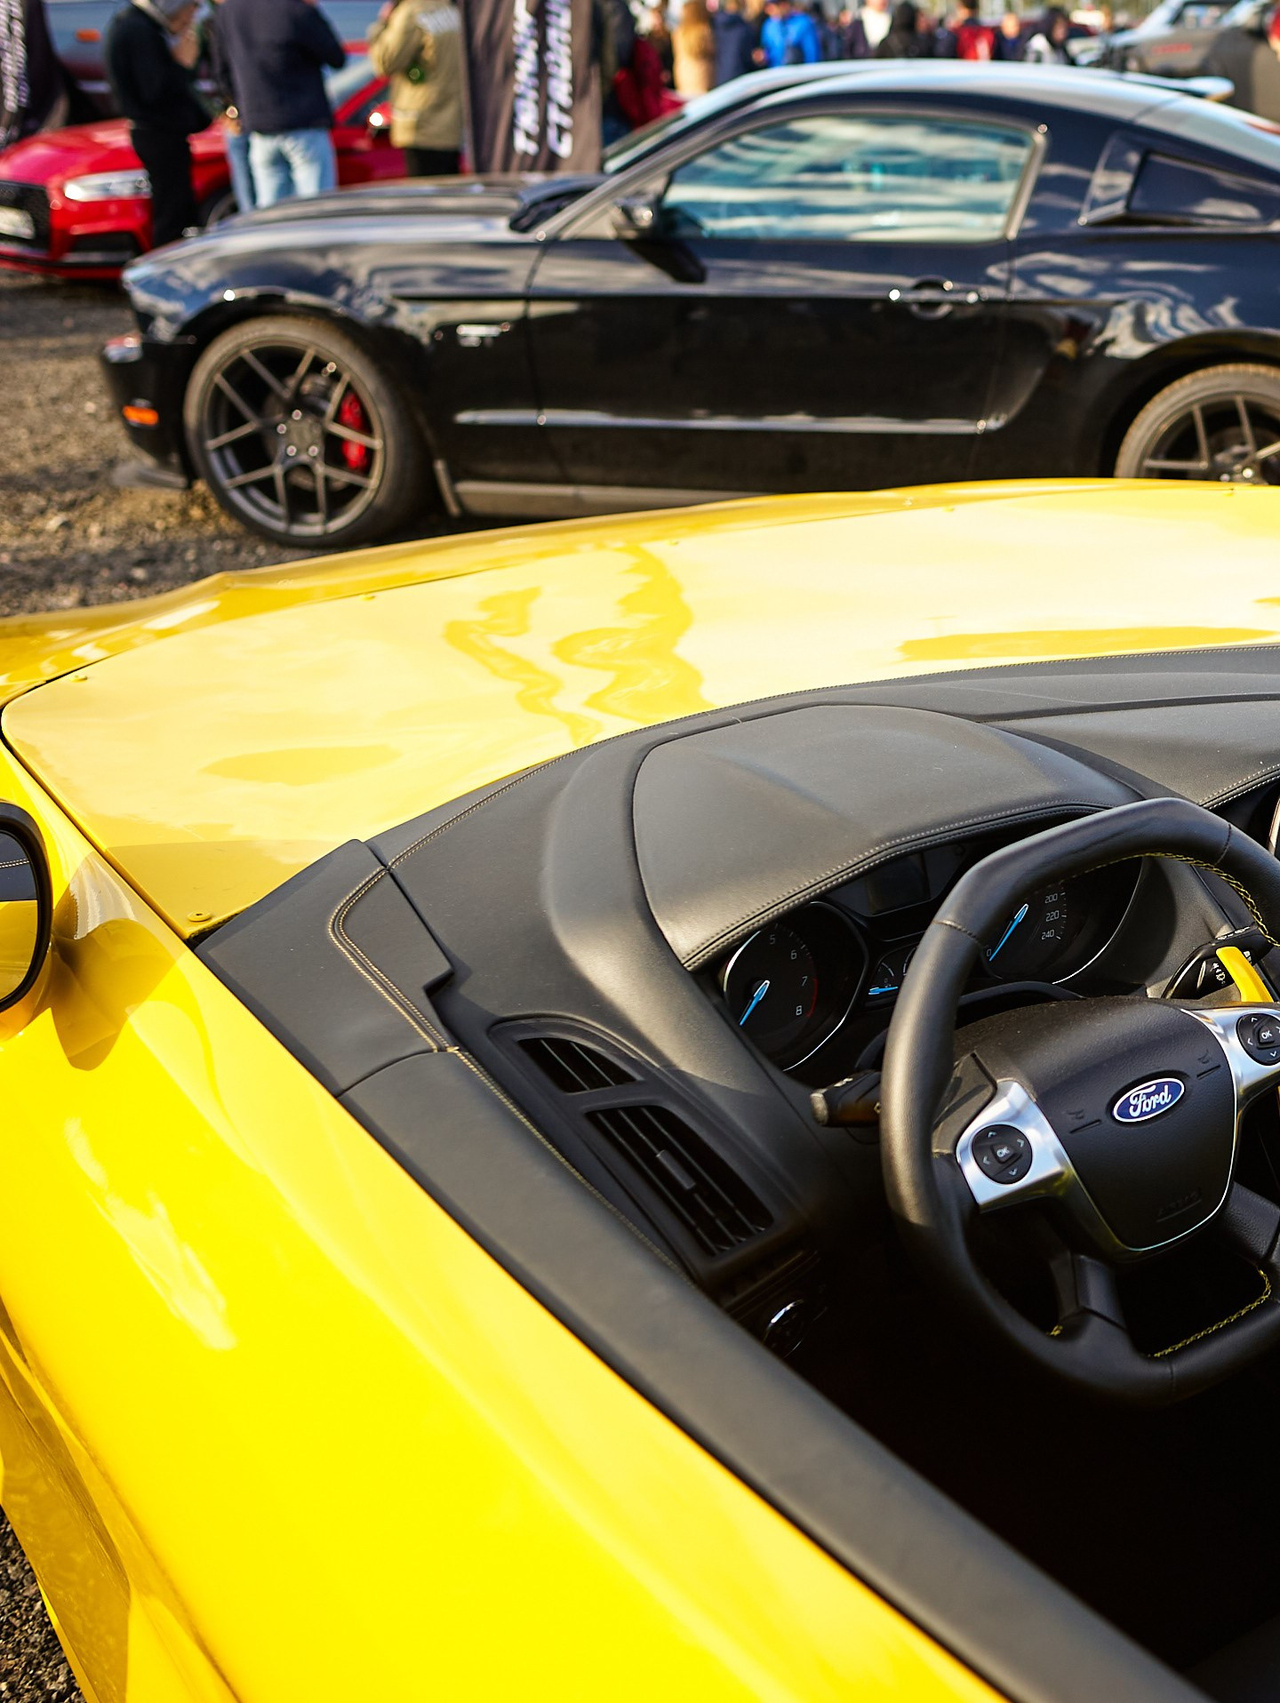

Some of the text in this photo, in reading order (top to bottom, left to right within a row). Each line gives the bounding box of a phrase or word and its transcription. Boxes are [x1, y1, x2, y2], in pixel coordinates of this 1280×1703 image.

[544, 0, 573, 158] СТАЙЛИ
[1044, 893, 1058, 904] 200
[1045, 910, 1060, 922] 220
[769, 934, 776, 945] 5
[1041, 929, 1055, 940] 240
[790, 950, 798, 960] 6
[801, 975, 808, 987] 7
[795, 1005, 803, 1016] 8
[1261, 1030, 1273, 1040] OK
[1128, 1084, 1172, 1117] Ford
[996, 1146, 1010, 1158] OK
